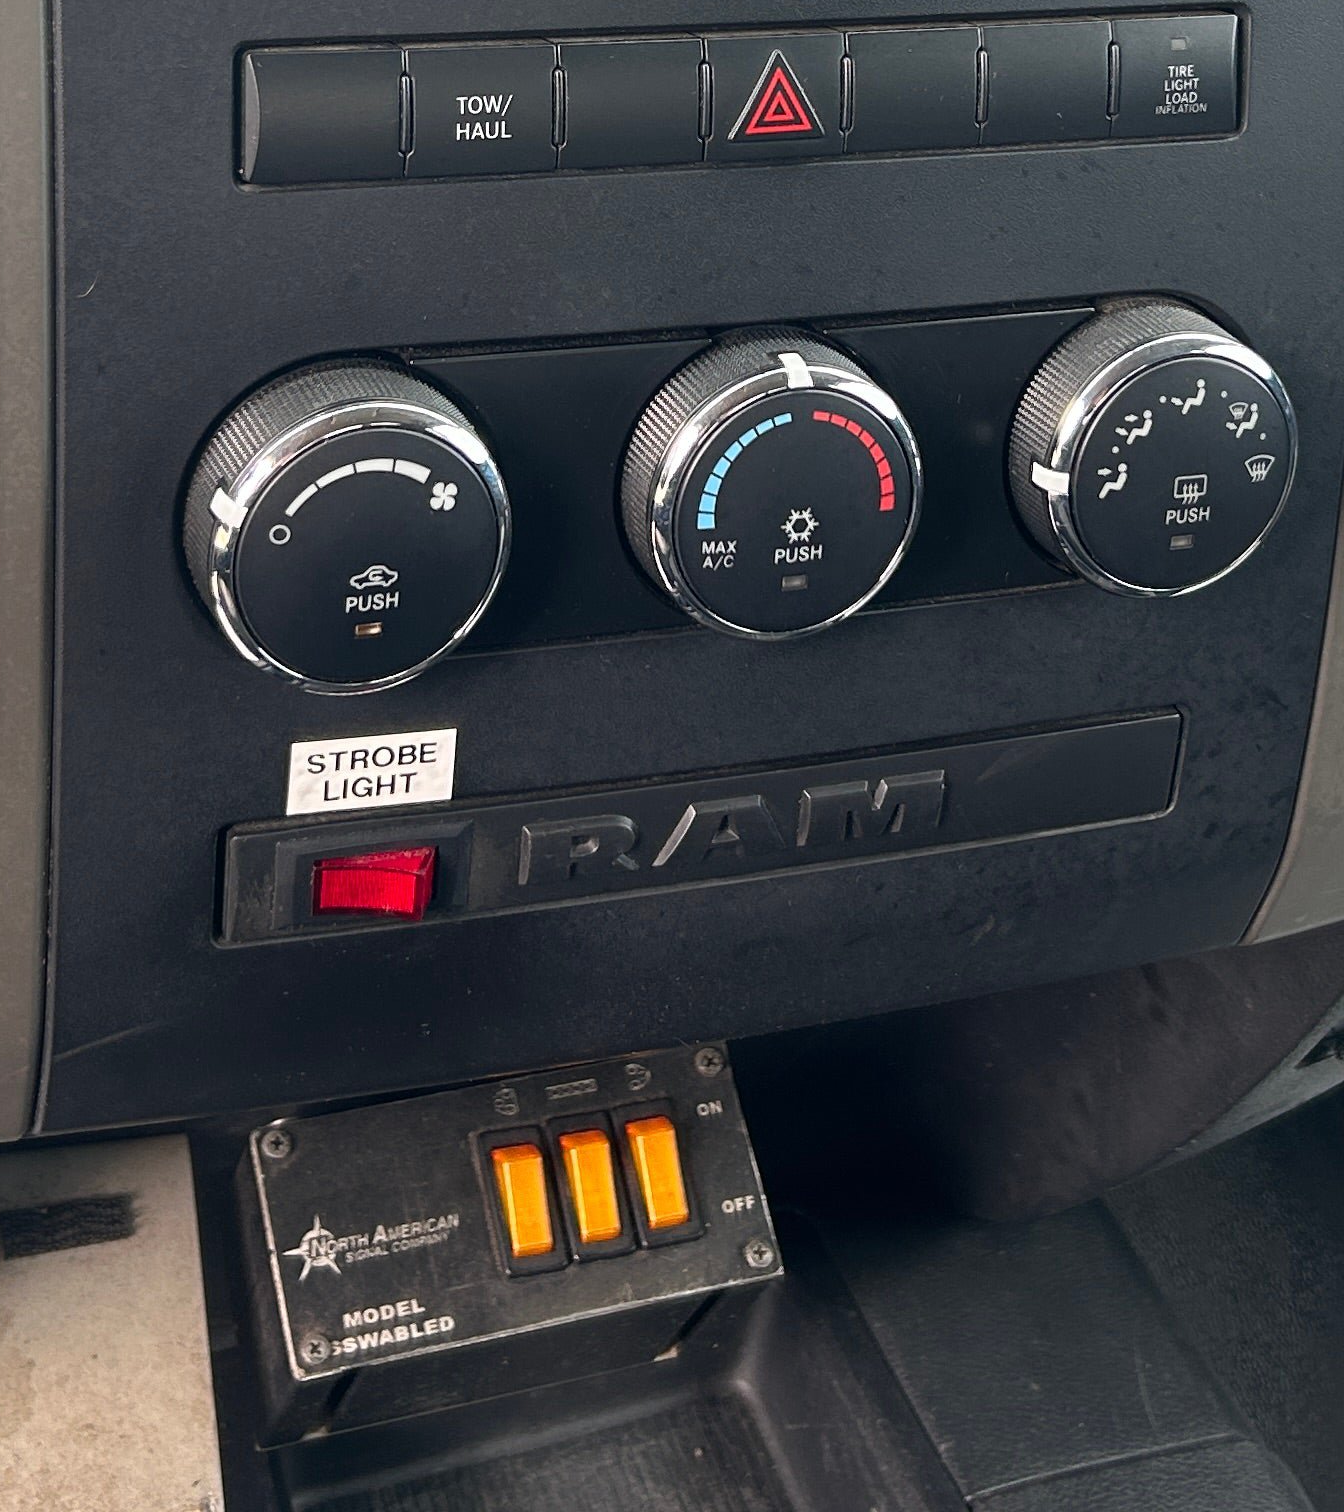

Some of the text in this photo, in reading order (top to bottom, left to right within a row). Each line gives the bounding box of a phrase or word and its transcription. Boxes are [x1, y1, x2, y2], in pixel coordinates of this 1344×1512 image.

[1167, 64, 1195, 78] TIRE
[1164, 77, 1200, 92] LIGHT
[456, 95, 513, 116] TOW/
[1165, 92, 1198, 105] LOAD
[1155, 103, 1208, 115] INFLATION
[457, 121, 511, 140] HAUL
[1166, 507, 1210, 524] PUSH
[702, 541, 736, 558] MAX
[775, 545, 822, 564] PUSH
[703, 555, 733, 570] A/C
[346, 592, 399, 613] PUSH
[307, 742, 438, 774] STROBE
[323, 772, 418, 802] LIGHT
[517, 769, 946, 886] RAM
[697, 1101, 722, 1115] ON
[722, 1196, 754, 1213] OFF
[309, 1213, 460, 1258] NORTH AMERICAN
[342, 1298, 426, 1329] MODEL
